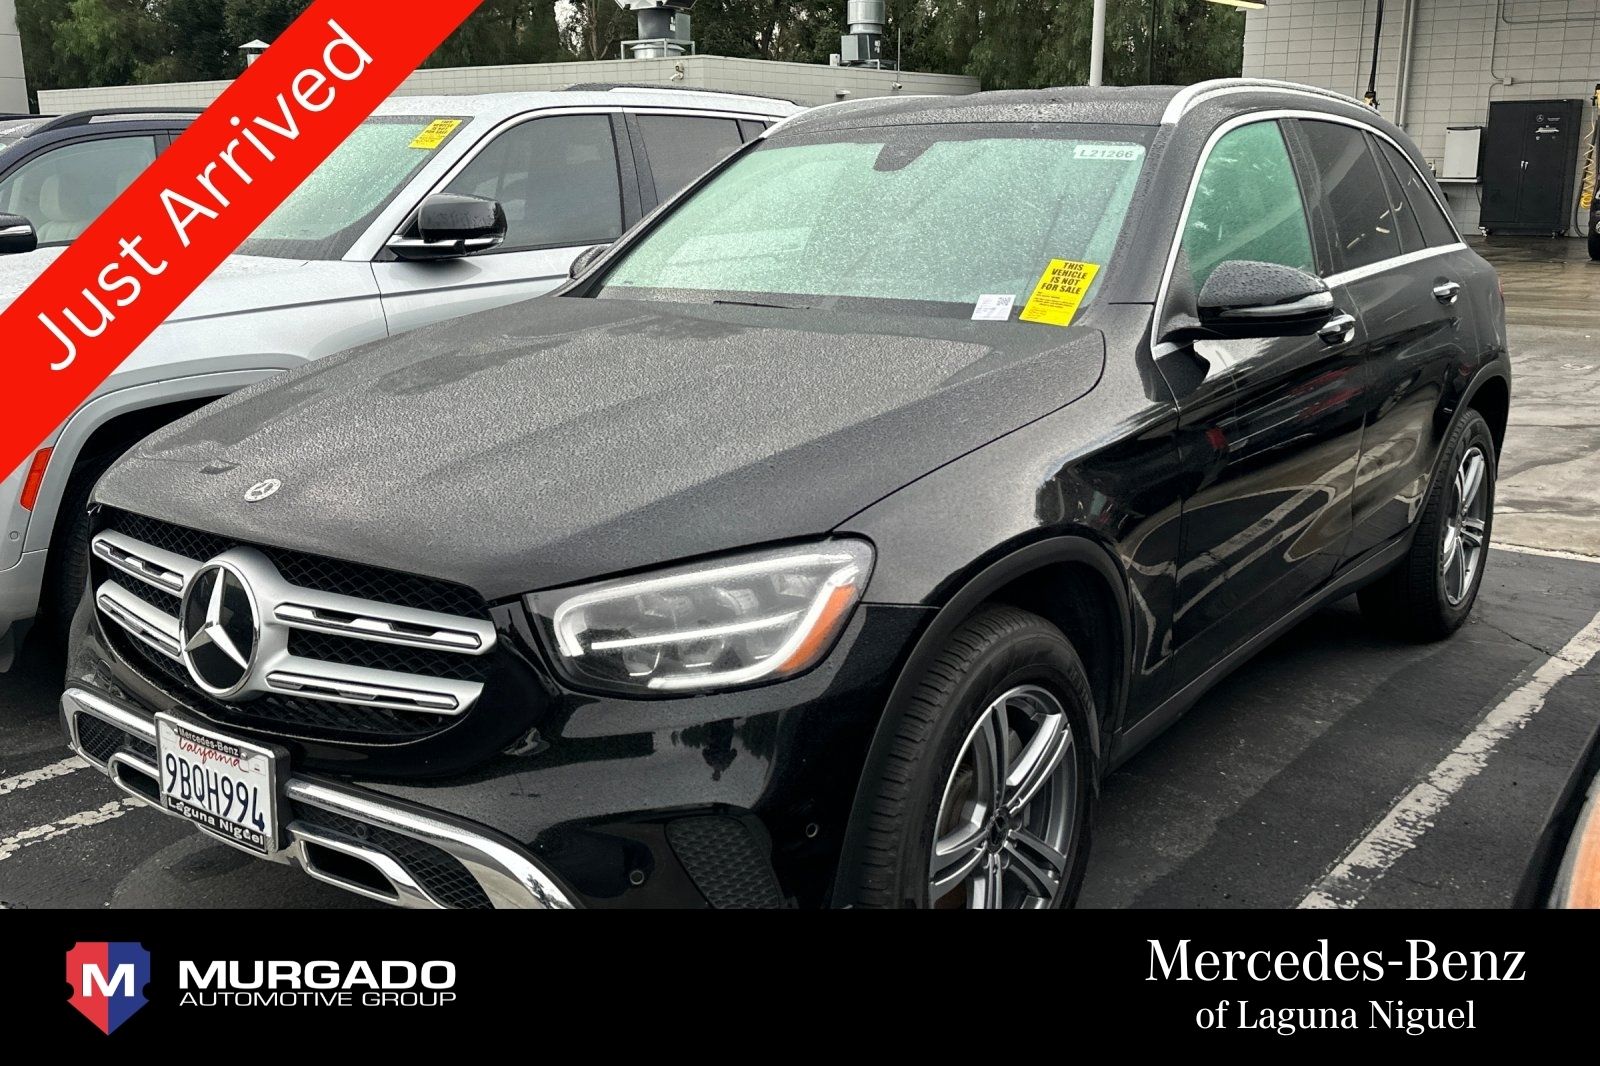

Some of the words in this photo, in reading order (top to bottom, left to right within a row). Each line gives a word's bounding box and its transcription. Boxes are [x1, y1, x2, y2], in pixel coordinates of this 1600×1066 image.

[1079, 149, 1134, 158] L21266
[1063, 262, 1084, 270] THIS
[1051, 268, 1088, 279] VEHICLE
[1062, 277, 1080, 286] NOT
[1041, 283, 1058, 291] FOR
[1059, 285, 1082, 294] SALE
[178, 727, 240, 757] Mercedes-Benz
[178, 737, 249, 773] California
[165, 753, 265, 832] 9BQH994
[168, 797, 215, 827] Laguna
[219, 819, 264, 845] Niguel
